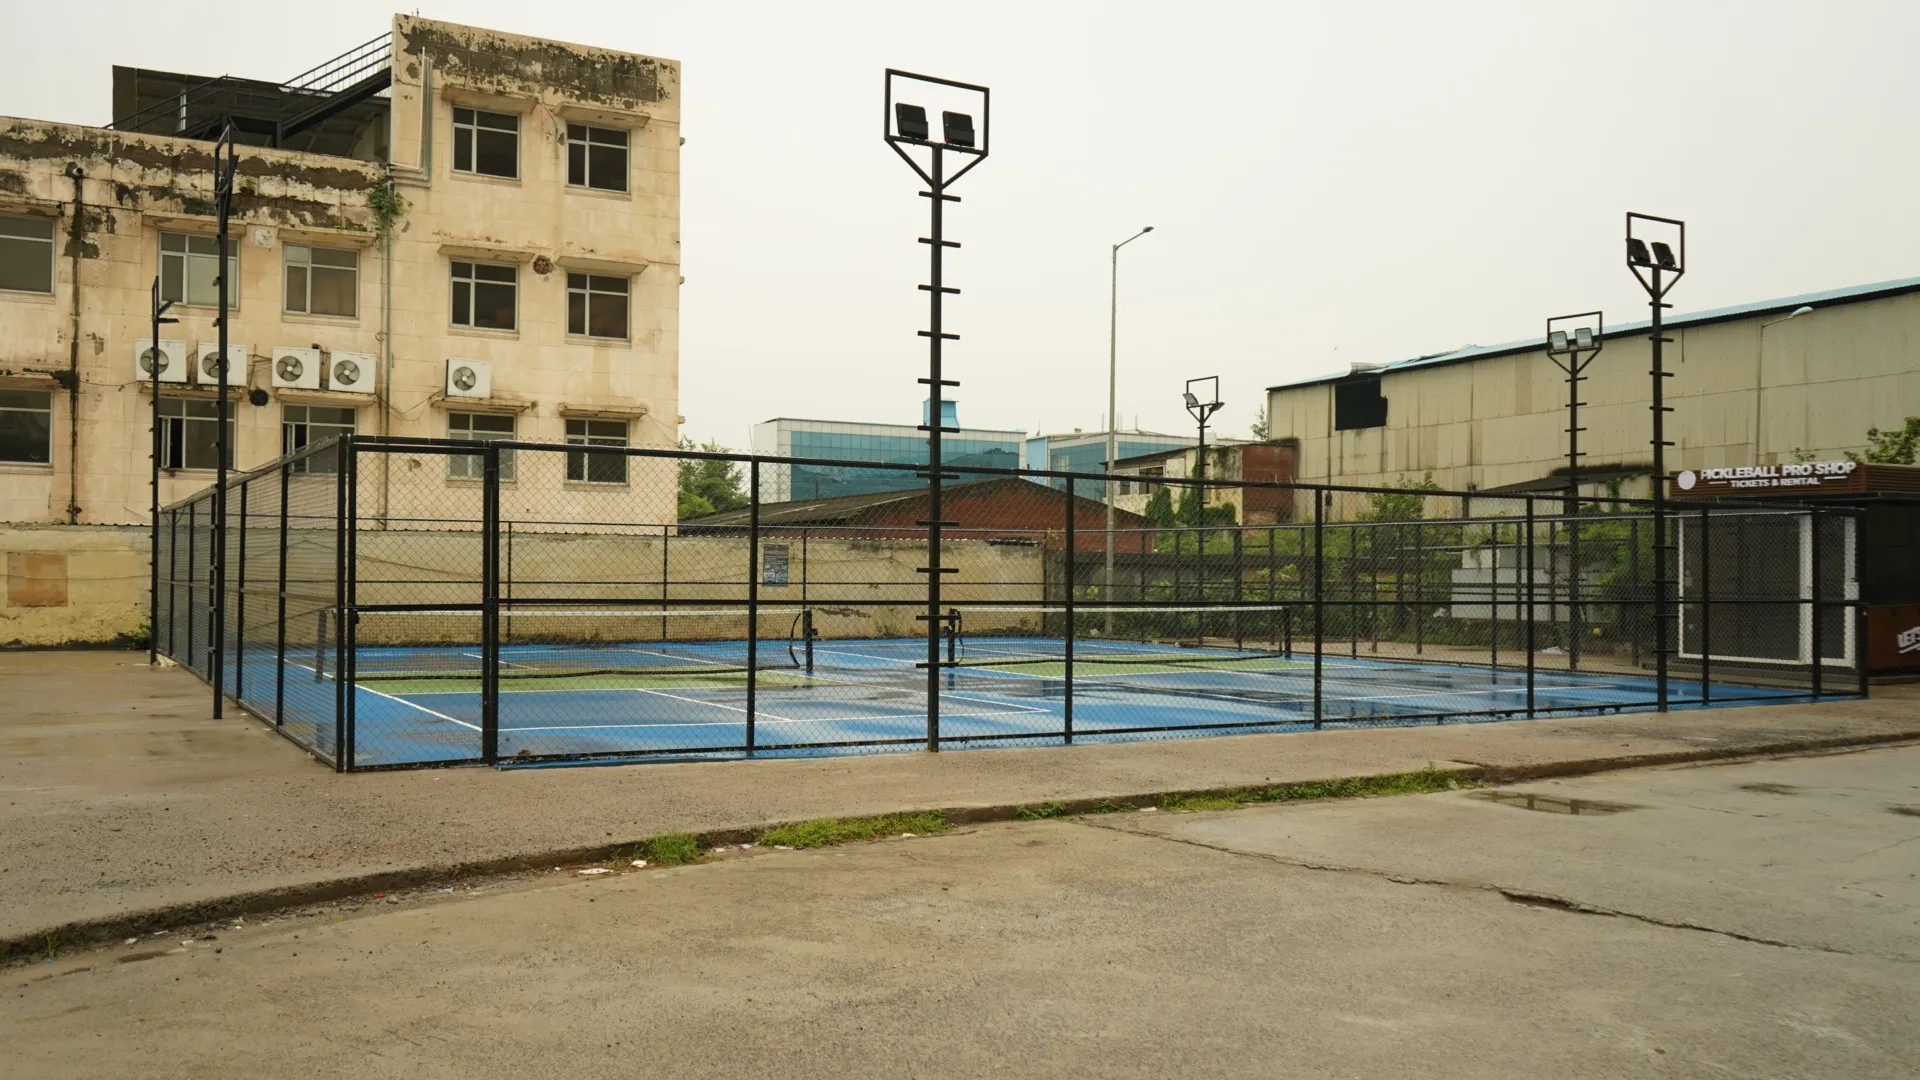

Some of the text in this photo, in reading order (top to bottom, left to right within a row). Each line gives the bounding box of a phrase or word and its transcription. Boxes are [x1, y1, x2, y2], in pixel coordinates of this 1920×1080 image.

[1701, 461, 1857, 480] PICKLEBALL PRO SHOP
[1731, 477, 1820, 488] TICKETS & RENTAL
